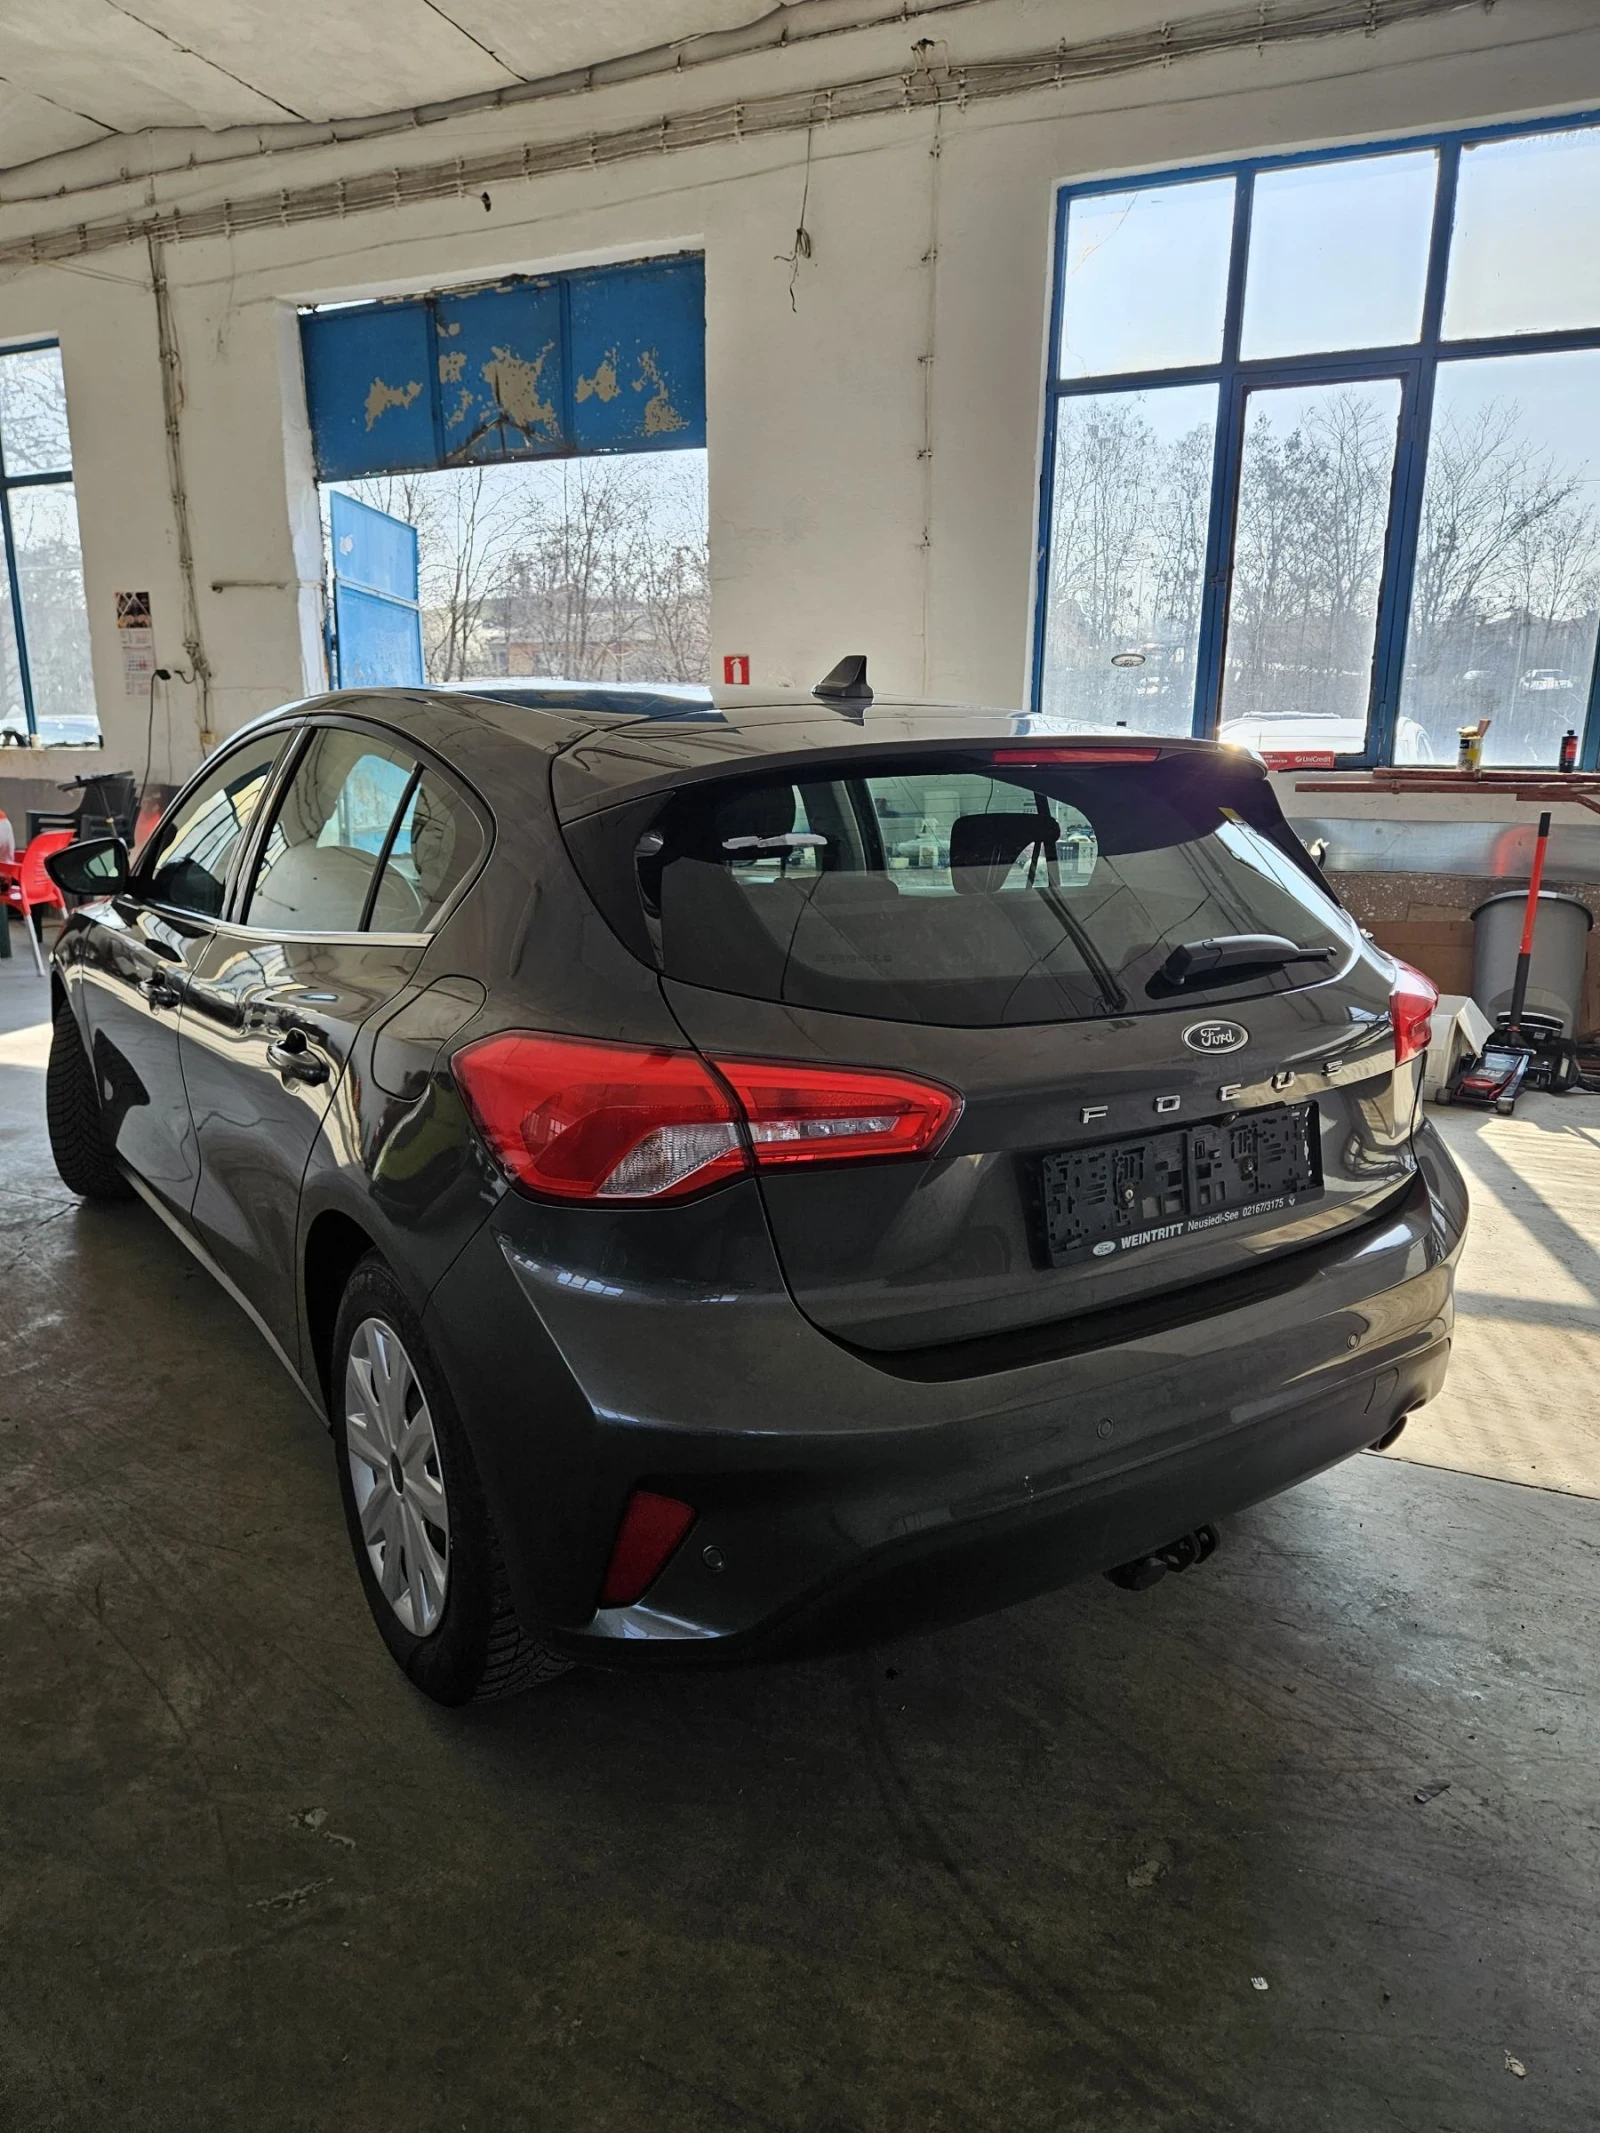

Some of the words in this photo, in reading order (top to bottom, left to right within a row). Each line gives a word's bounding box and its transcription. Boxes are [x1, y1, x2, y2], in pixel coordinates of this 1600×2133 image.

[1302, 755, 1331, 763] UniCredit
[1200, 1026, 1236, 1047] Ford
[1080, 1061, 1343, 1124] FOCUS
[1121, 1222, 1184, 1249] WEINTRITT
[1187, 1209, 1239, 1231] Neusiedl-See
[1242, 1198, 1285, 1217] 02167/3175
